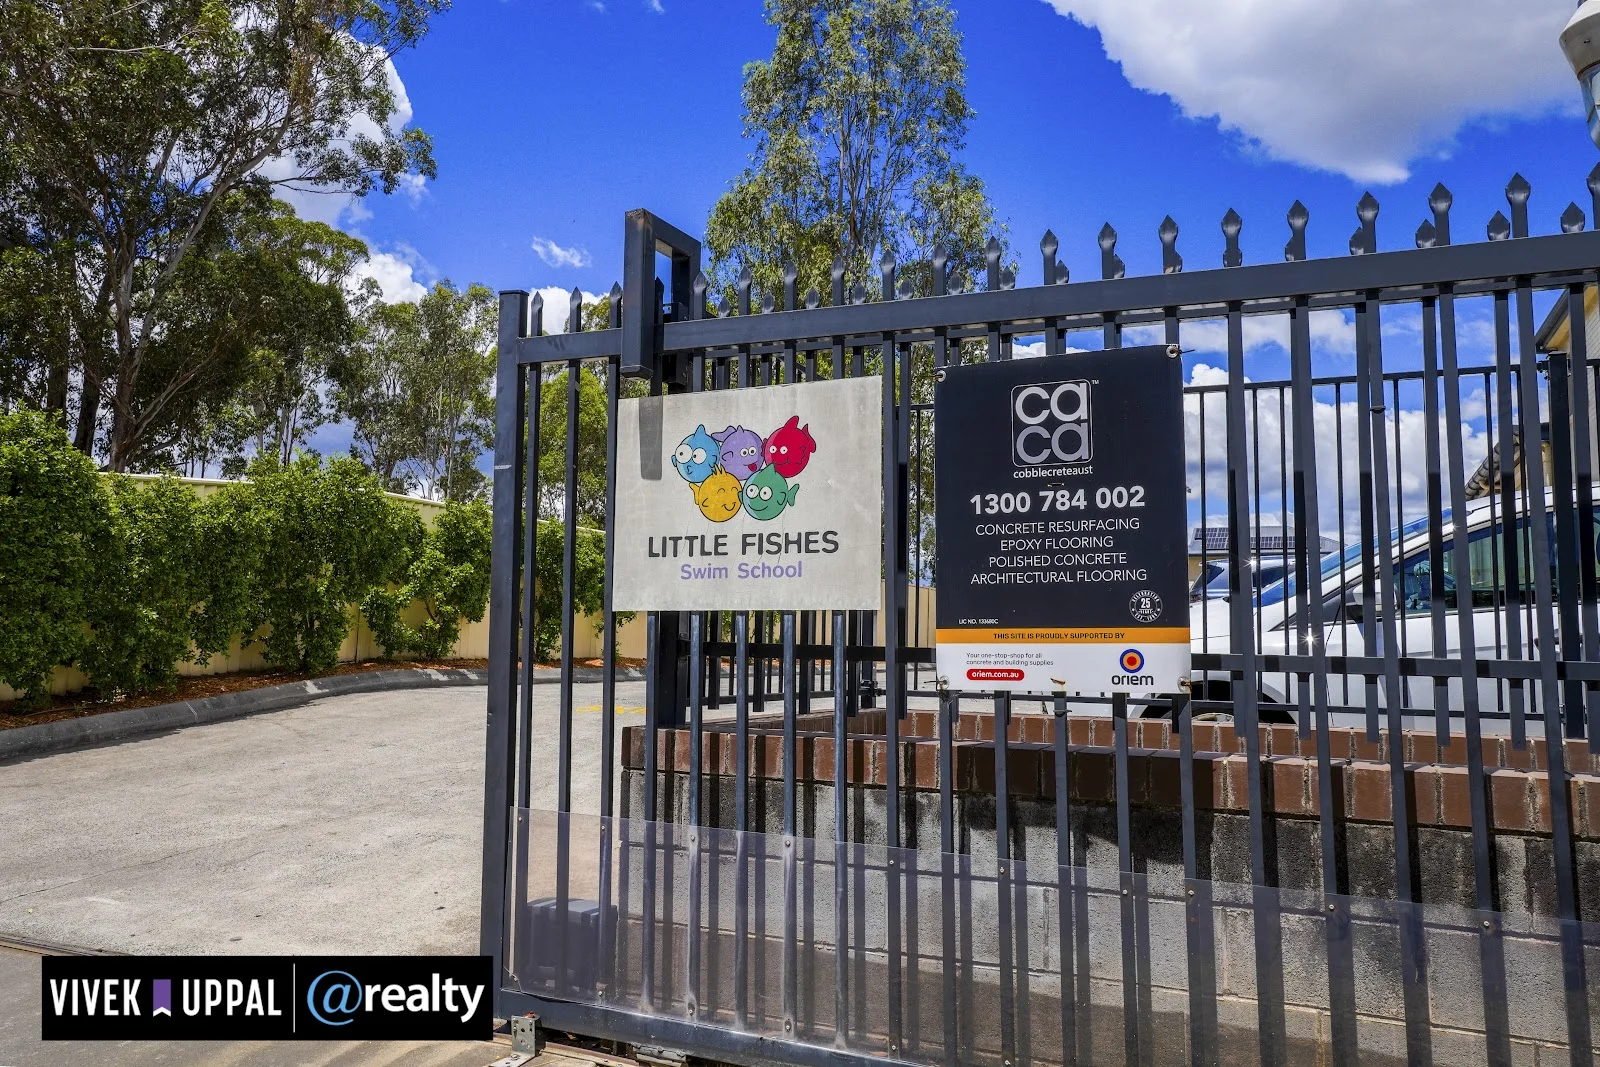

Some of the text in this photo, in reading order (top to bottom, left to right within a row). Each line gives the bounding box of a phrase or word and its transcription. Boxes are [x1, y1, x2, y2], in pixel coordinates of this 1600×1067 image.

[1013, 465, 1093, 479] cobblecreteaust
[970, 485, 1145, 514] 1300 784 002
[975, 518, 1140, 536] CONCRETE RESURFACING
[649, 530, 839, 558] LITTLE FISHES
[1000, 536, 1114, 551] EPOXY FLOORING
[989, 552, 1127, 568] POLISHED CONCRETE
[680, 560, 803, 580] Swim School
[970, 569, 1147, 585] ARCHITECTURAL FLOORING
[1140, 597, 1151, 609] 25
[981, 652, 1024, 660] one-stop-shop
[971, 670, 1019, 678] oriem.com.au
[1111, 675, 1154, 686] oriem
